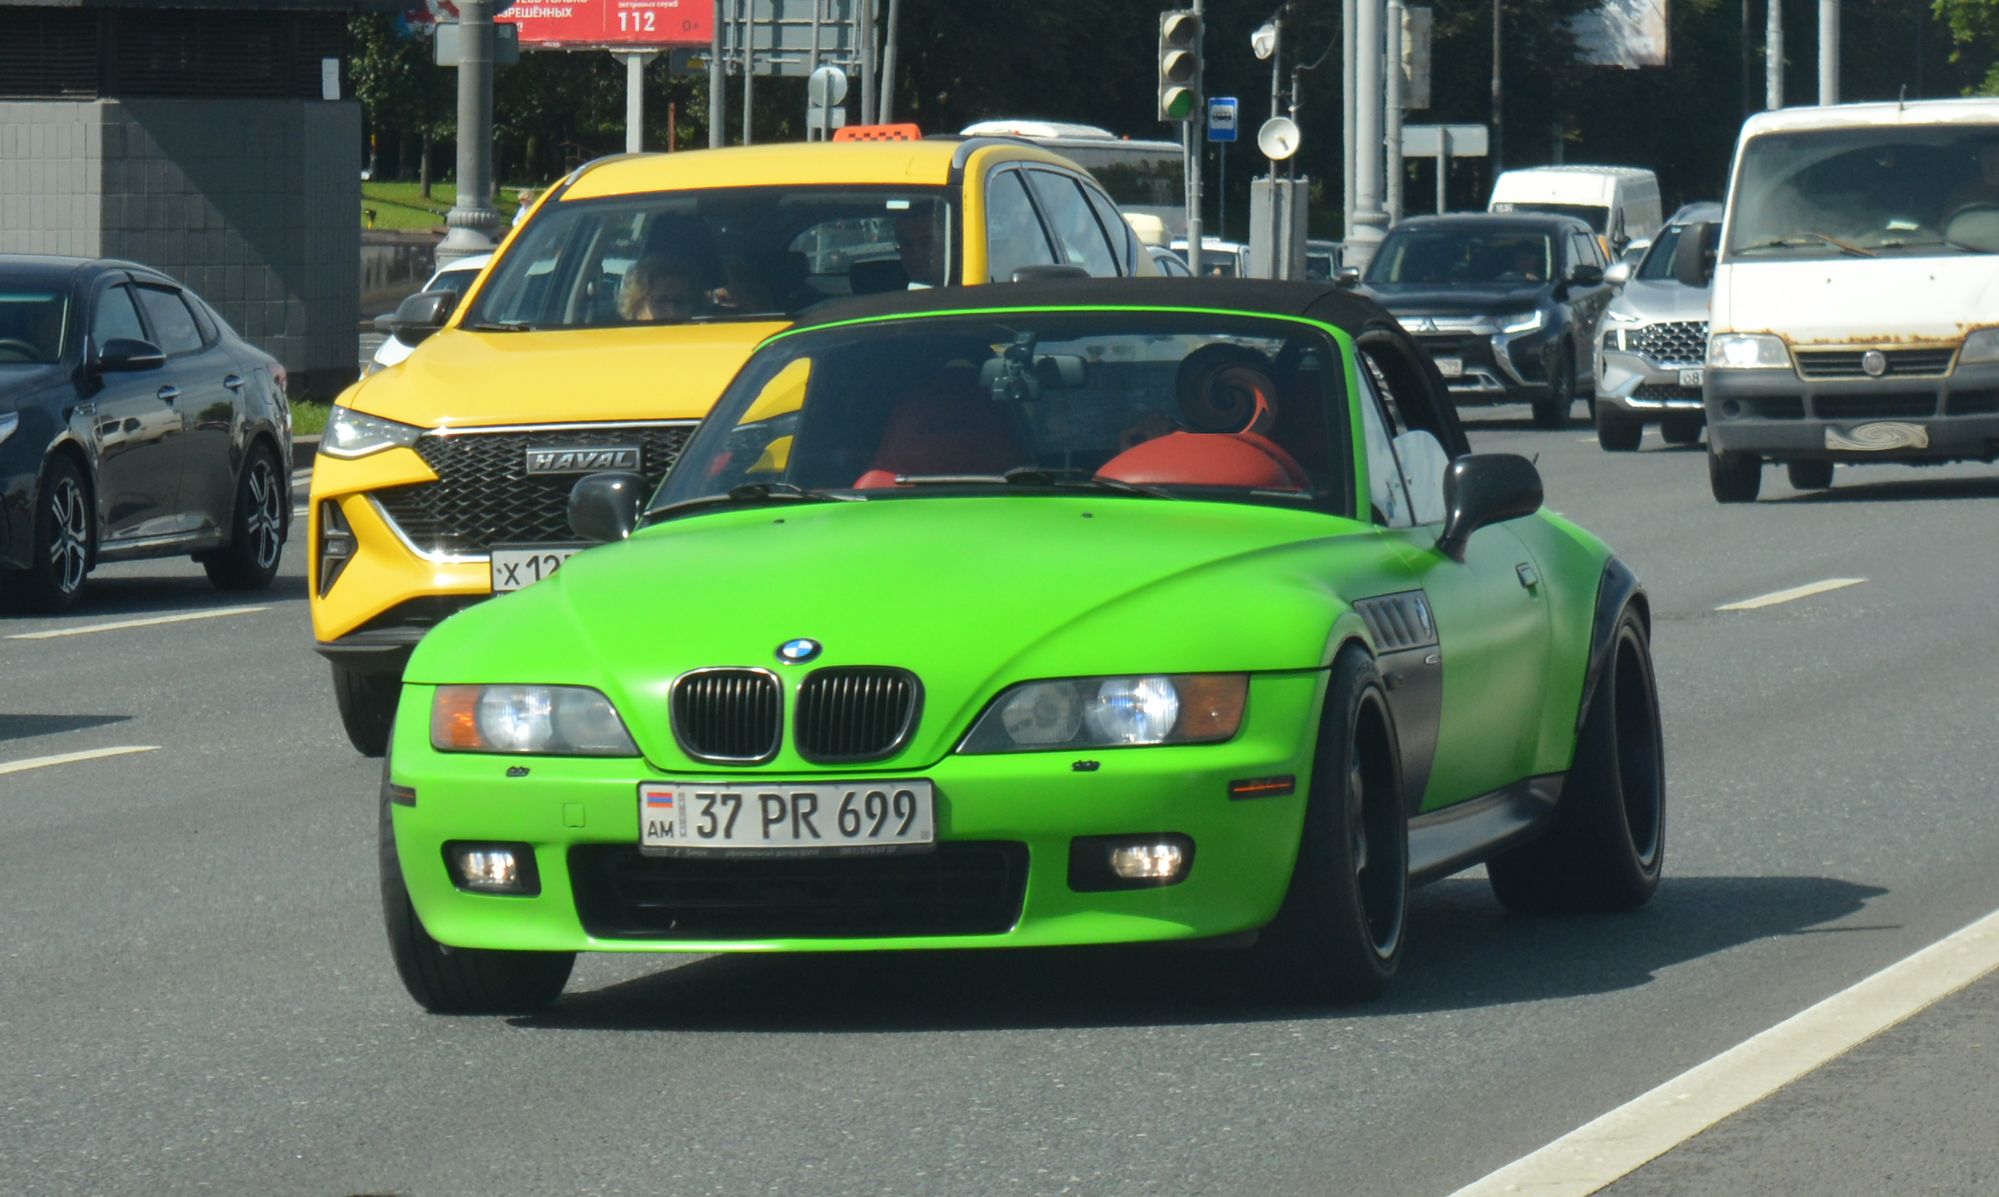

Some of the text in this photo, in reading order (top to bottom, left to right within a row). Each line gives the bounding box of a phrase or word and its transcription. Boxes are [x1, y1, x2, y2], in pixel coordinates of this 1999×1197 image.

[497, 7, 572, 18] ЗРЕШЁННЫХ
[618, 12, 655, 32] 112
[682, 20, 699, 31] 0+
[534, 452, 633, 470] HAVAL
[695, 789, 916, 839] 37 PR 699
[647, 820, 674, 838] AM
